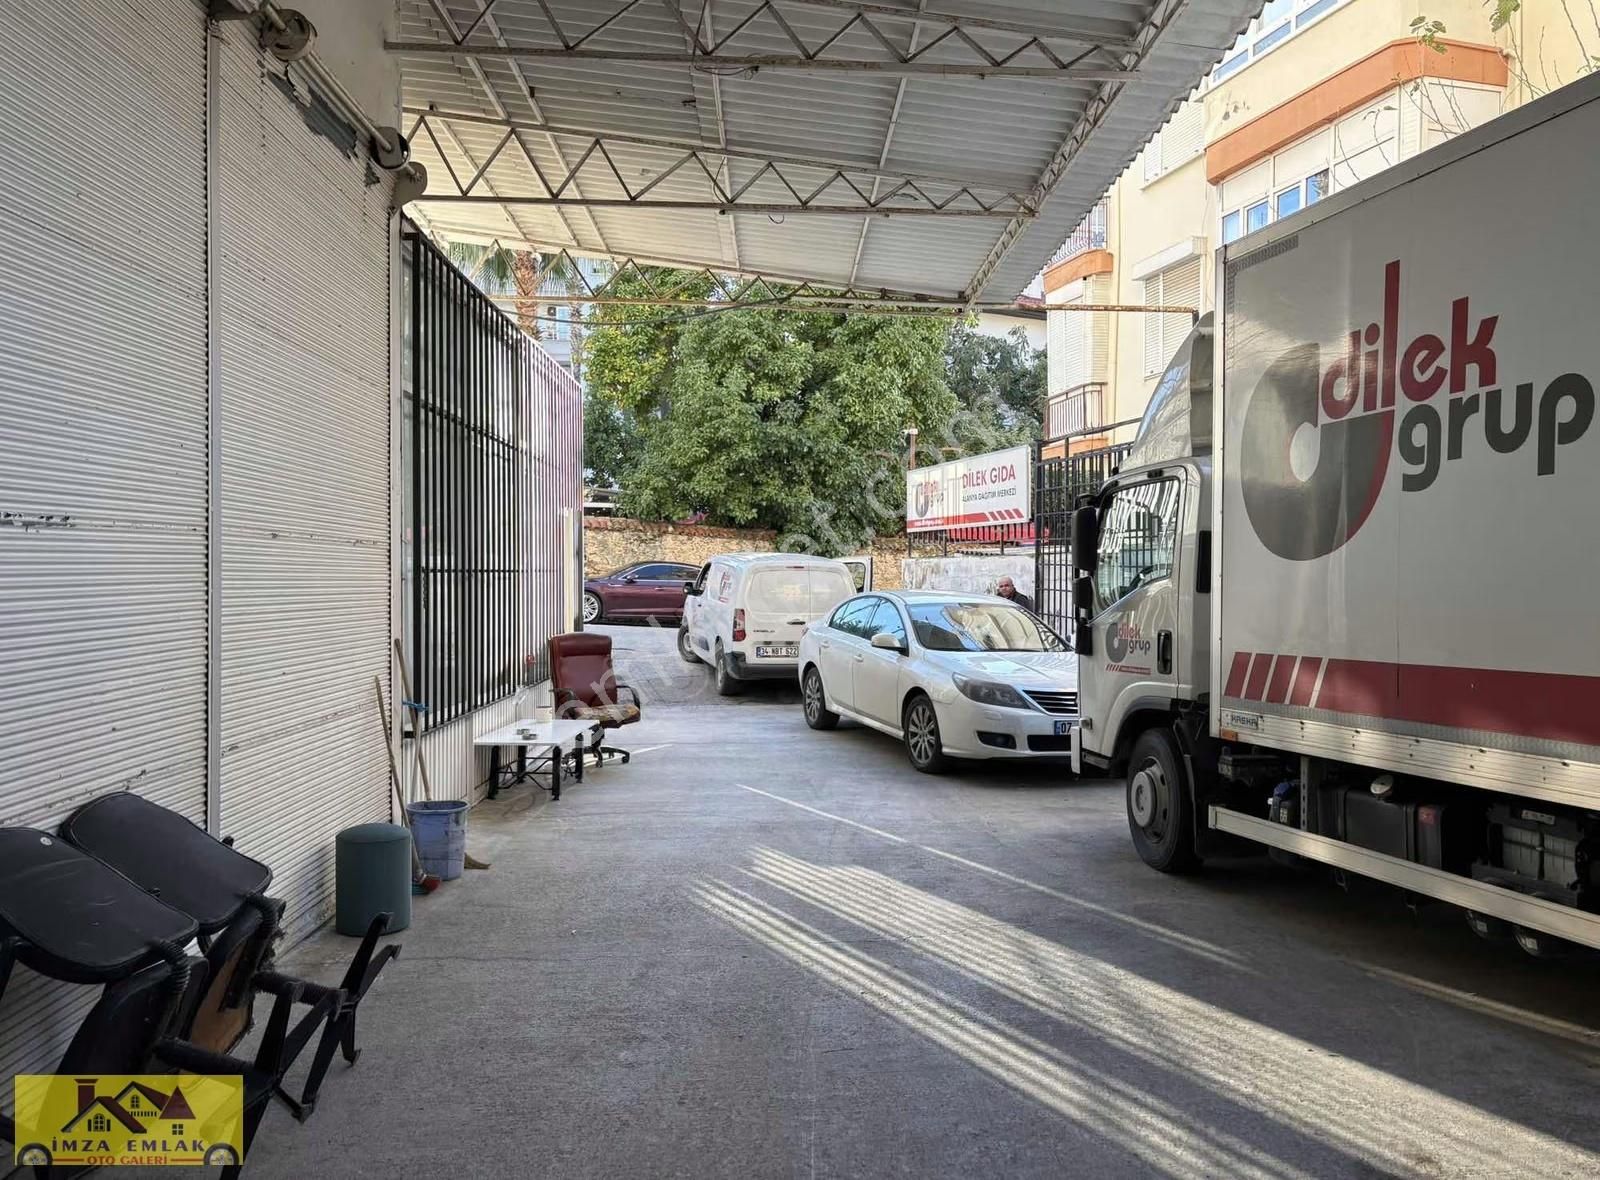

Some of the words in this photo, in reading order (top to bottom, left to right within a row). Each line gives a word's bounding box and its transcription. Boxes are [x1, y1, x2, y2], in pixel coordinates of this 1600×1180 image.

[1321, 259, 1499, 420] dilek
[1398, 373, 1595, 492] grup
[962, 468, 987, 489] DİLEK
[990, 464, 1016, 484] GIDA
[1129, 640, 1151, 656] grup
[1061, 723, 1072, 734] 07
